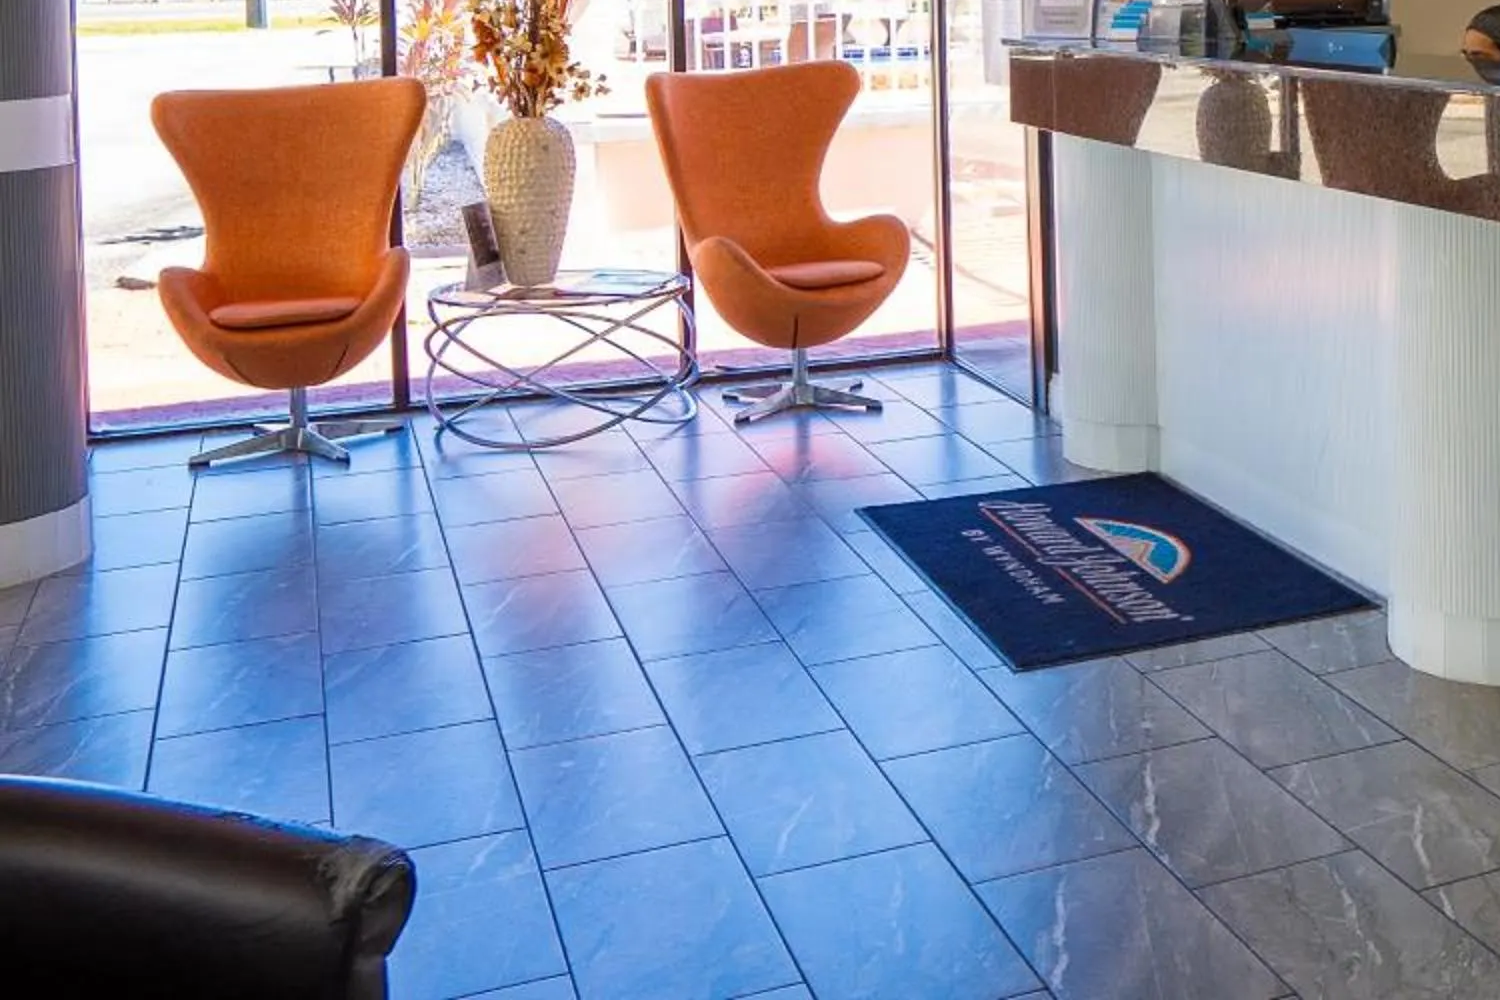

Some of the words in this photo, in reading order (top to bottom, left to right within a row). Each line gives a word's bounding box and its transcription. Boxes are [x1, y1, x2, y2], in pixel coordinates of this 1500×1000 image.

[977, 500, 1104, 554] Howard
[961, 528, 993, 543] BY
[982, 545, 1066, 605] WYNDHAM
[1036, 552, 1180, 623] Johnson
